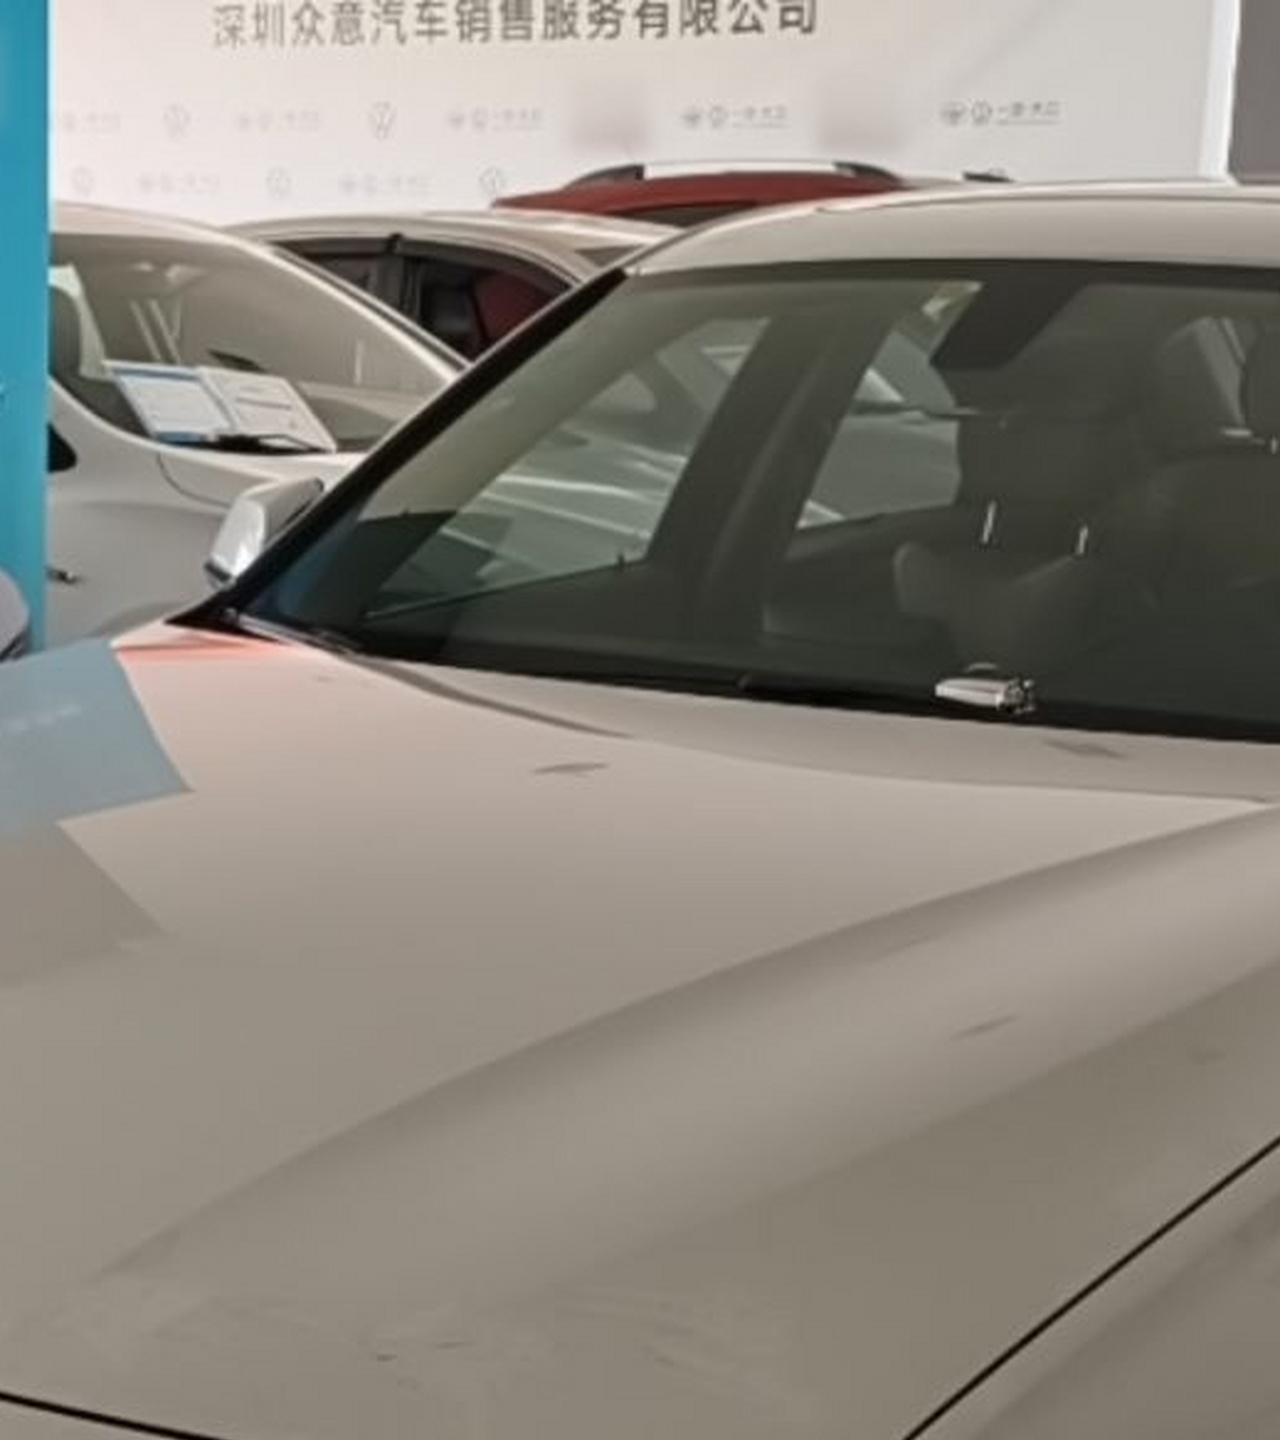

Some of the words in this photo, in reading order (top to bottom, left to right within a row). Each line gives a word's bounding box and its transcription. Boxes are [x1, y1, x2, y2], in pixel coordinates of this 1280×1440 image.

[214, 0, 817, 47] 深圳众意汽车销售服务有限公司
